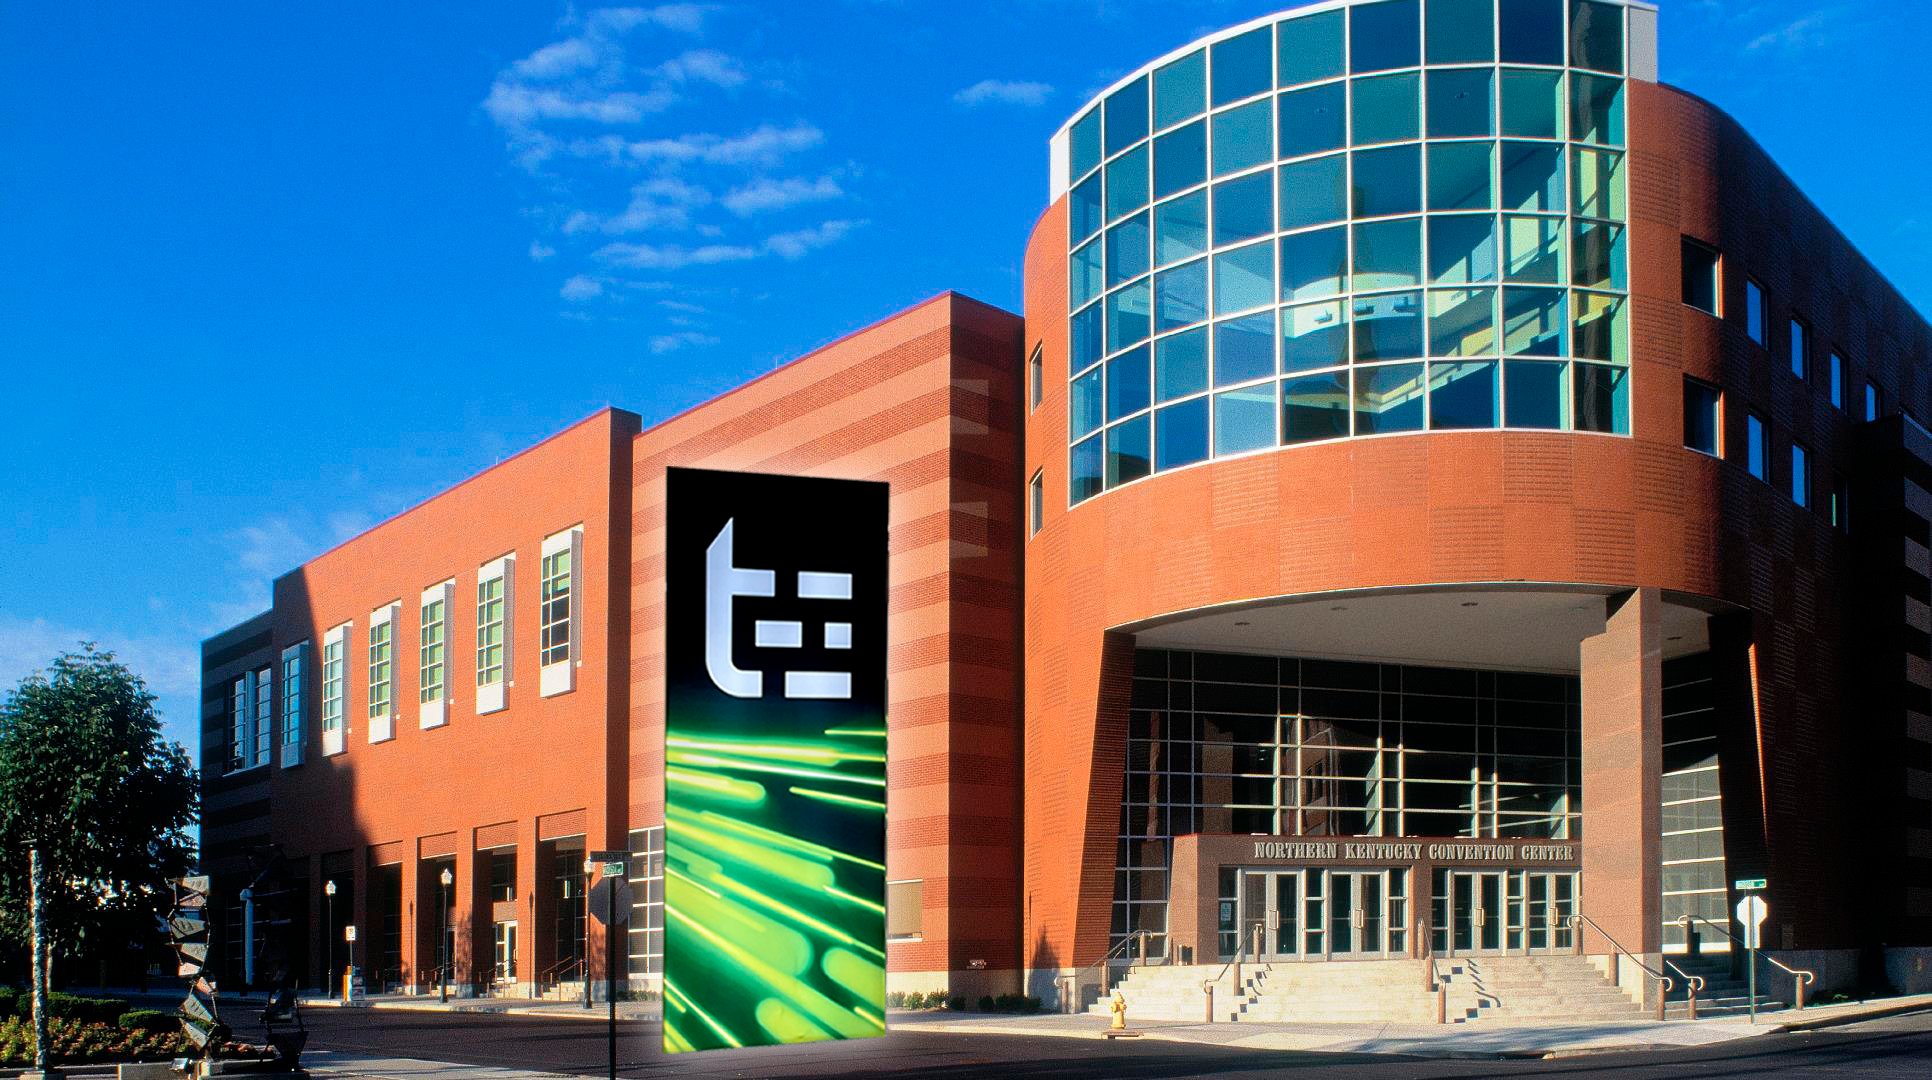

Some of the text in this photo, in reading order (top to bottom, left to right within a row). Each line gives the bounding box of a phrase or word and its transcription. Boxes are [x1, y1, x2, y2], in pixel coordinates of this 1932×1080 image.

[1254, 842, 1574, 860] NORTHERN KENTUCKY CONVENTION CENTER
